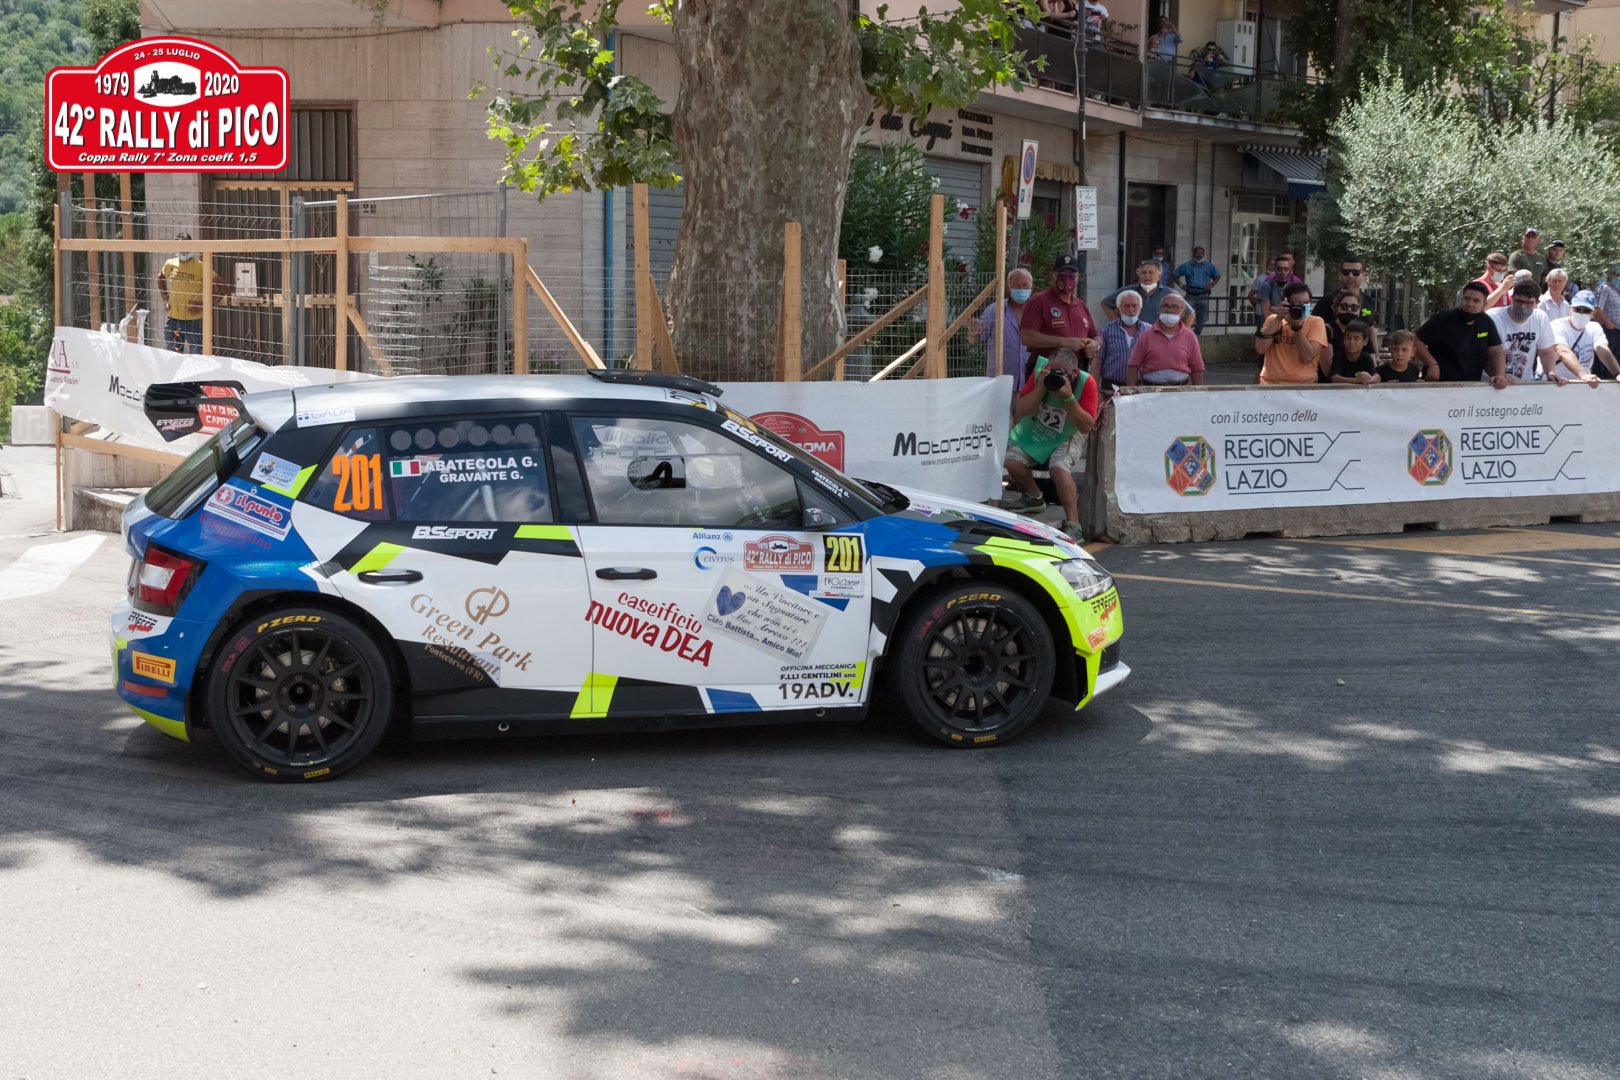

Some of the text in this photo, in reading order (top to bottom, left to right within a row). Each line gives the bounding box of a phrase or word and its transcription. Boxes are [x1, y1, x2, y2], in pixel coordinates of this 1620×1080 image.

[1210, 409, 1318, 426] con il sostegno della
[1447, 404, 1543, 420] con il sostegno della
[1224, 437, 1315, 460] REGIONE
[1460, 430, 1541, 451] REGIONE
[424, 456, 538, 473] ABATECOLA G.
[1461, 459, 1517, 480] LAZIO
[331, 453, 383, 512] 201
[439, 470, 524, 484] GRAVANTE G.
[1225, 468, 1288, 490] LAZIO
[245, 501, 284, 522] punto
[692, 532, 721, 540] Allianz
[760, 552, 782, 565] RALLY
[784, 551, 792, 565] di
[793, 551, 812, 565] PICO
[826, 536, 860, 572] 201
[617, 592, 703, 634] caseificio
[761, 600, 810, 625] Sognatore
[773, 592, 813, 616] Vincitore
[747, 608, 763, 619] che
[763, 616, 781, 628] non
[410, 593, 534, 672] Green Park
[584, 600, 714, 668] nuova DEA
[706, 613, 724, 626] Ciao
[761, 637, 785, 652] Amico
[785, 646, 802, 659] Mio!
[420, 624, 501, 676] Restaurant
[136, 656, 171, 678] PIRELLI
[424, 643, 485, 681] Pontecorvo (FR)
[780, 664, 814, 672] OFFICINA
[780, 673, 800, 681] F.LLI
[801, 671, 842, 680] GENTILINI
[778, 681, 854, 700] 19ADV.
